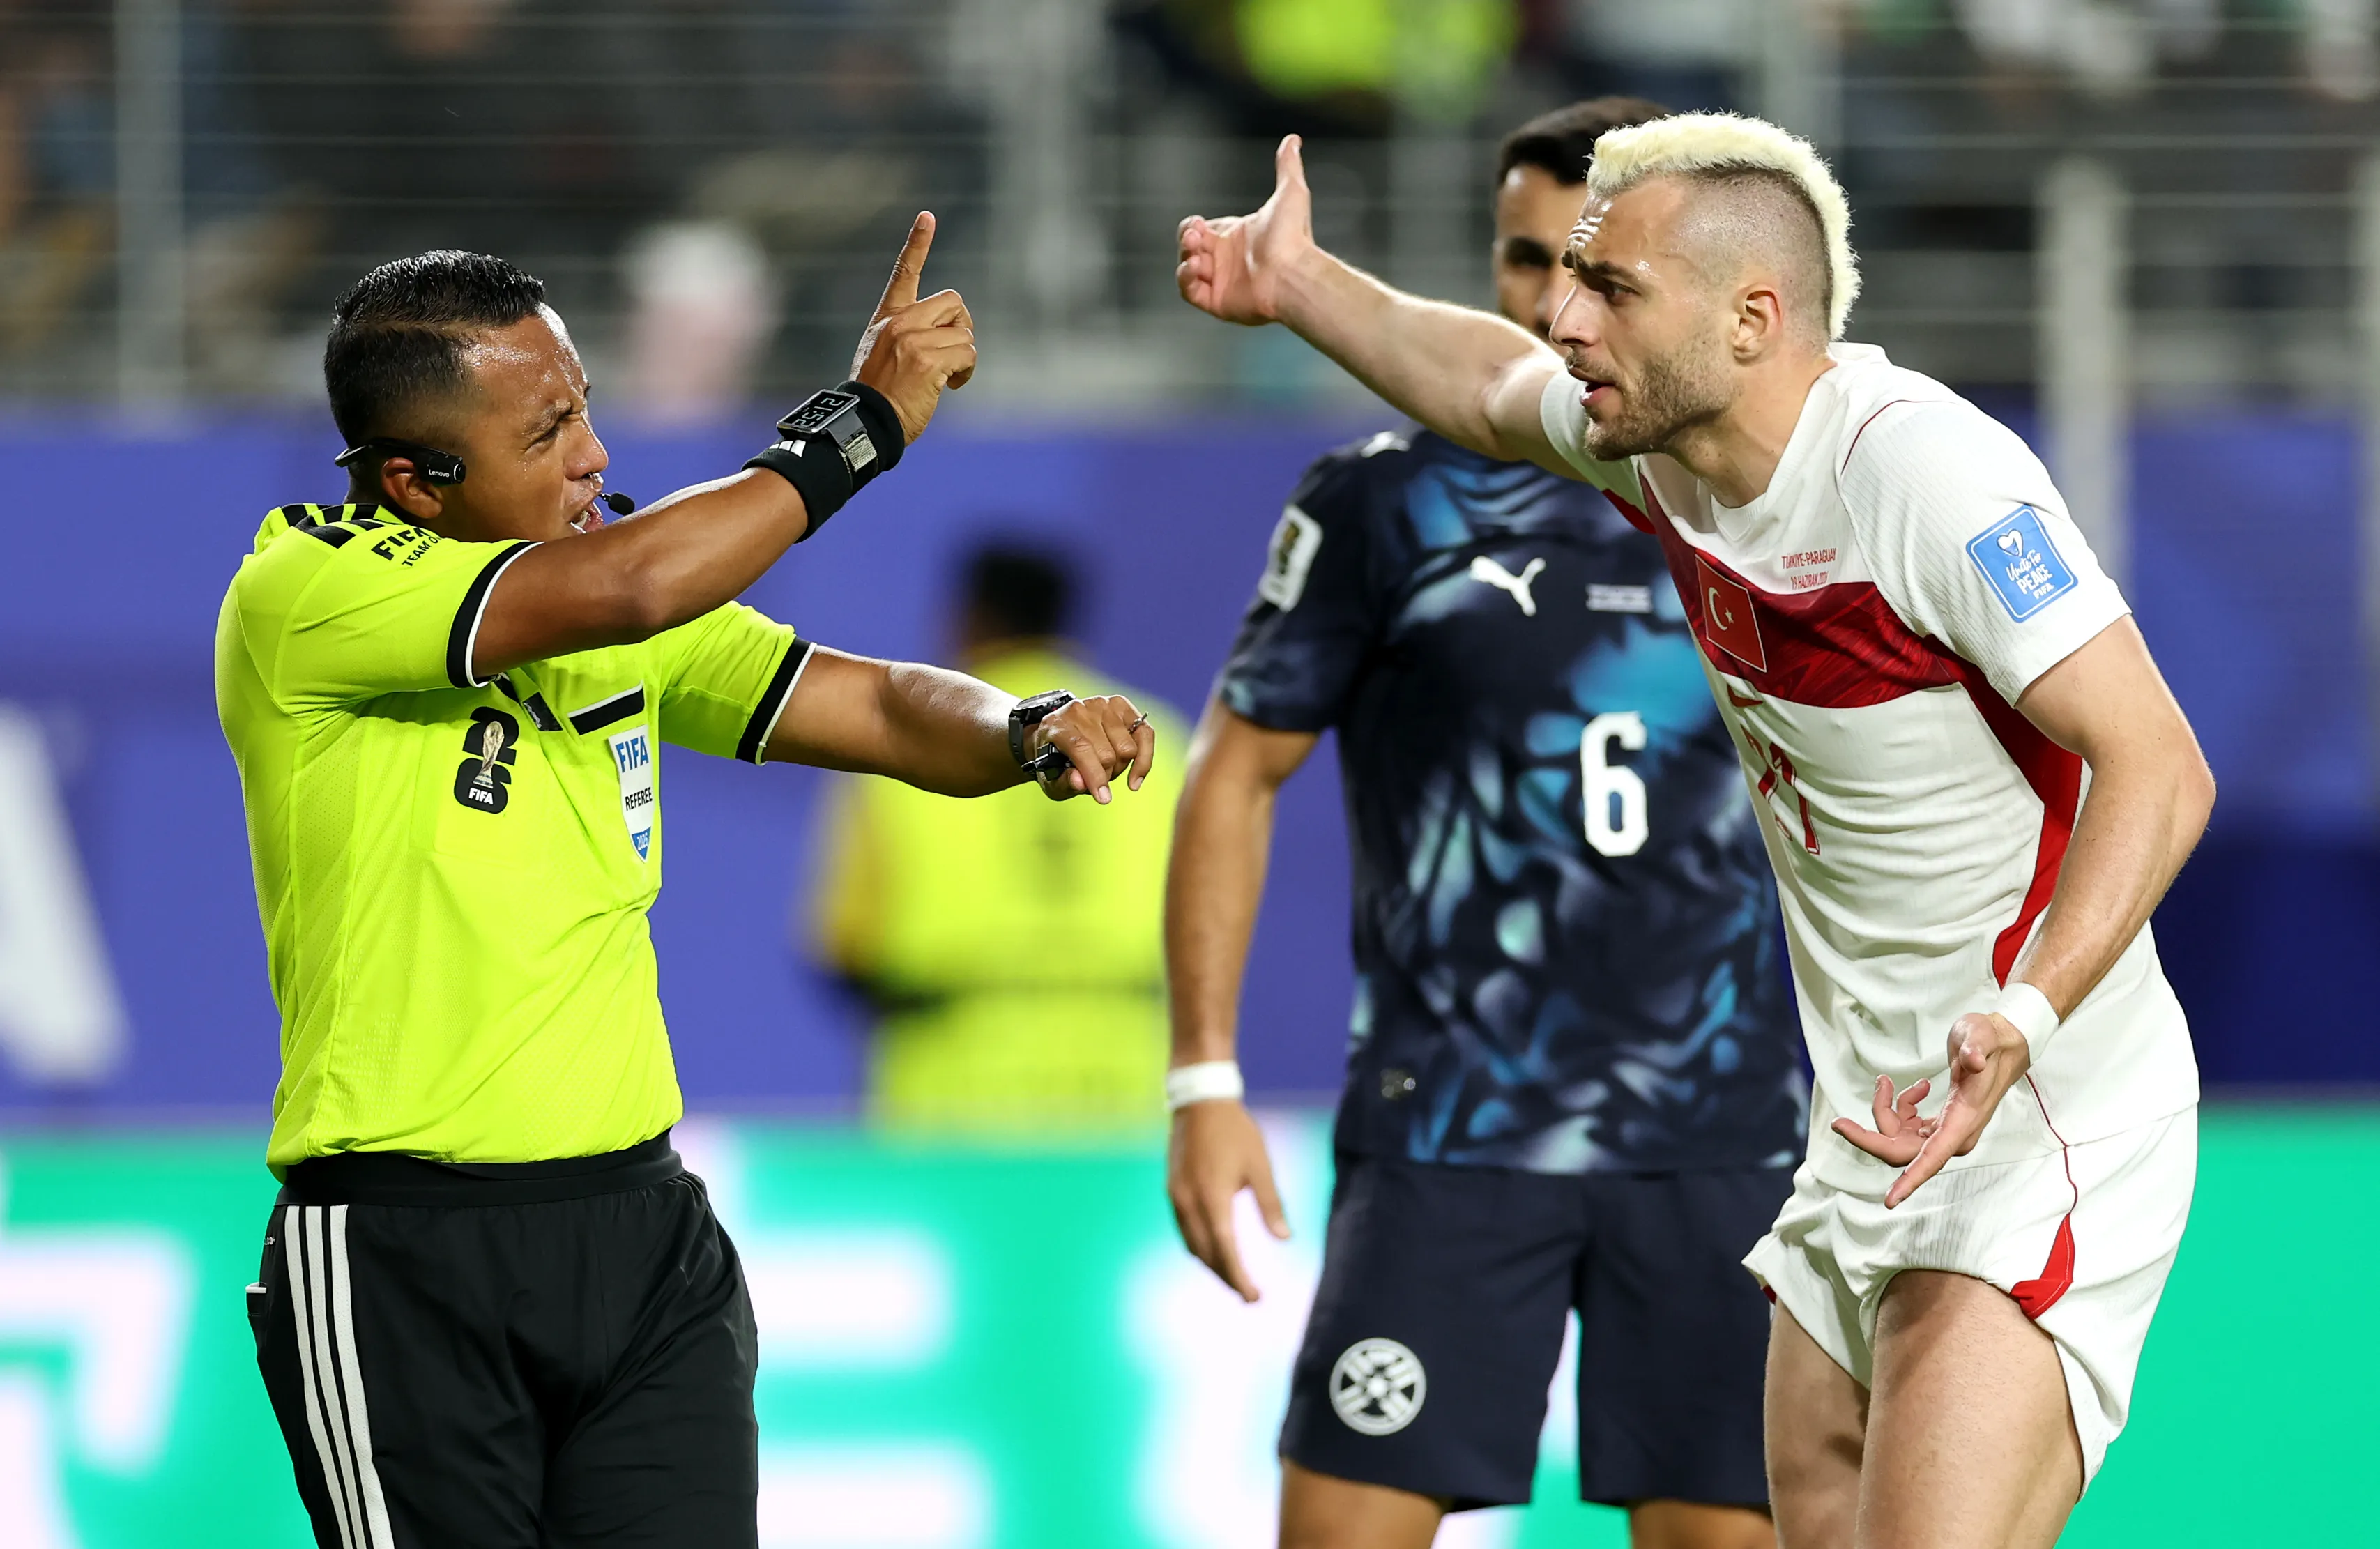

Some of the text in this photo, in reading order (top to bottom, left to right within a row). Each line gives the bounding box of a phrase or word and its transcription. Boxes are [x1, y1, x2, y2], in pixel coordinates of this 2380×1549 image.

[429, 469, 450, 478] Lenovo
[402, 540, 432, 566] TEAM
[2016, 563, 2053, 595] PEACE
[2033, 583, 2055, 600] FIFA
[615, 735, 649, 773] FIFA
[468, 787, 494, 804] FIFA
[1580, 711, 1649, 857] 6
[625, 786, 653, 811] REFEREE
